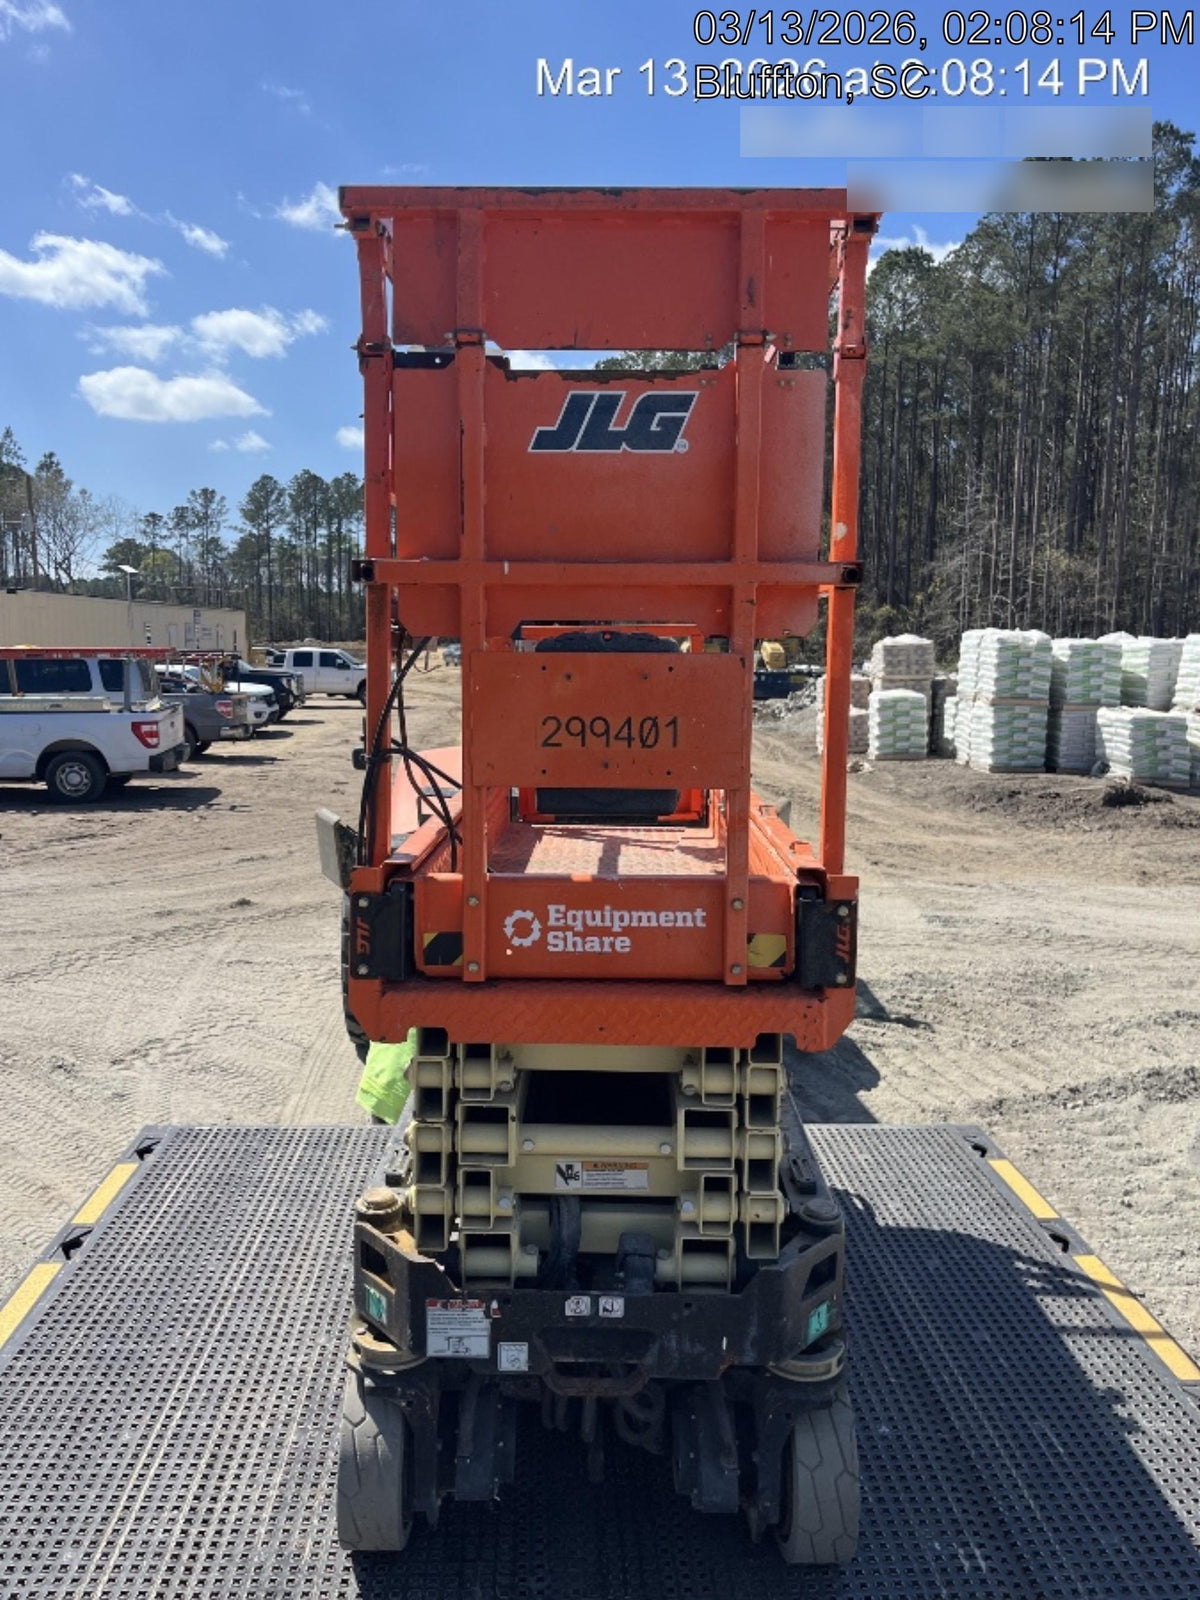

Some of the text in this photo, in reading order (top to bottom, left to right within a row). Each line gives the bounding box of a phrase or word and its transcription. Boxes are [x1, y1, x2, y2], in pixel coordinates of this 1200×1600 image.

[527, 390, 700, 453] JLG
[541, 716, 678, 748] 299401
[356, 916, 370, 955] JLG
[547, 904, 707, 932] Equipment
[547, 930, 631, 953] Share
[836, 922, 851, 963] JLG
